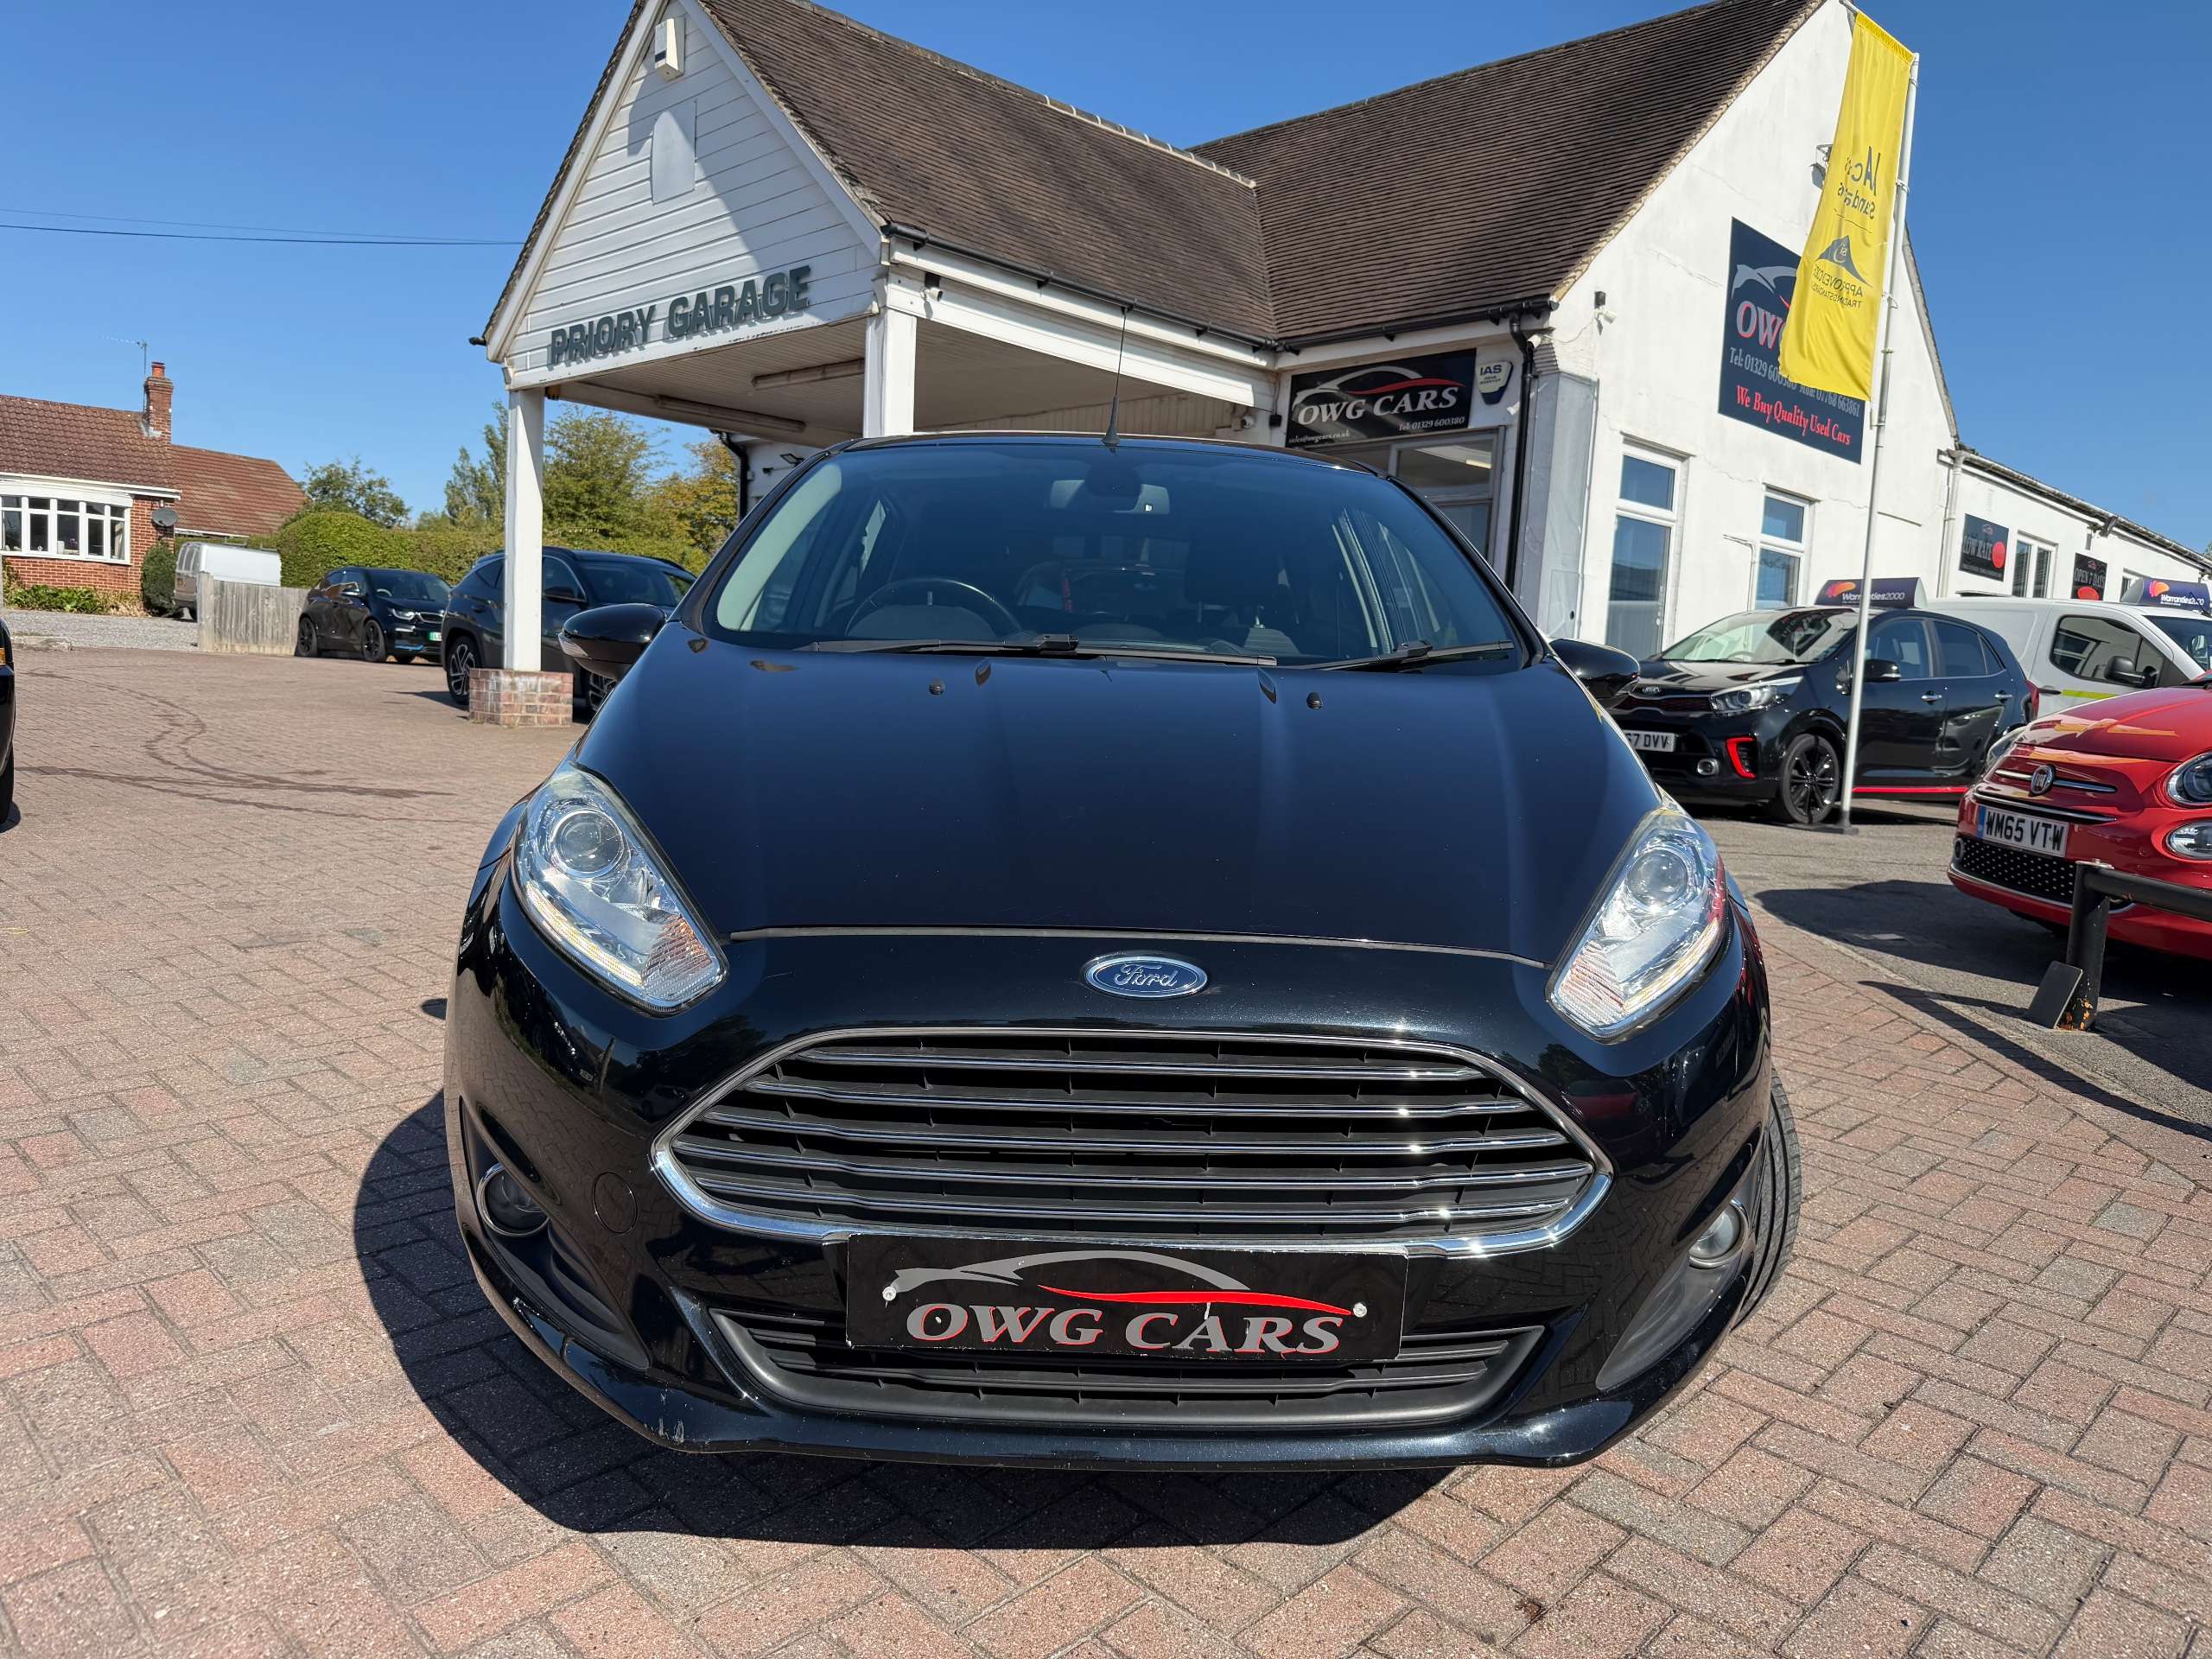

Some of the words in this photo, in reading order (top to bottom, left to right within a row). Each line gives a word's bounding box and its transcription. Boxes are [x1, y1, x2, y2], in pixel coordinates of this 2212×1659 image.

[550, 305, 656, 365] PRIORY
[668, 265, 810, 337] GARAGE
[1737, 301, 1784, 349] OW
[1480, 365, 1502, 376] IAS
[1730, 347, 1744, 367] Tel:
[1745, 354, 1767, 378] 01329
[1298, 399, 1366, 425] OWG
[1373, 387, 1459, 416] CARS
[1411, 420, 1433, 429] 01329
[1434, 416, 1465, 427] 600380
[1737, 385, 1750, 407] We
[1753, 391, 1772, 423] Buy
[1773, 401, 1809, 436] Quality
[1810, 414, 1831, 437] Used
[1831, 424, 1852, 445] Cars
[1644, 734, 1669, 748] DVV
[1986, 810, 2025, 842] WM65
[2031, 820, 2064, 851] VTW
[1114, 963, 1179, 988] Ford
[906, 1302, 1103, 1345] OWG
[1125, 1312, 1345, 1357] CARS
